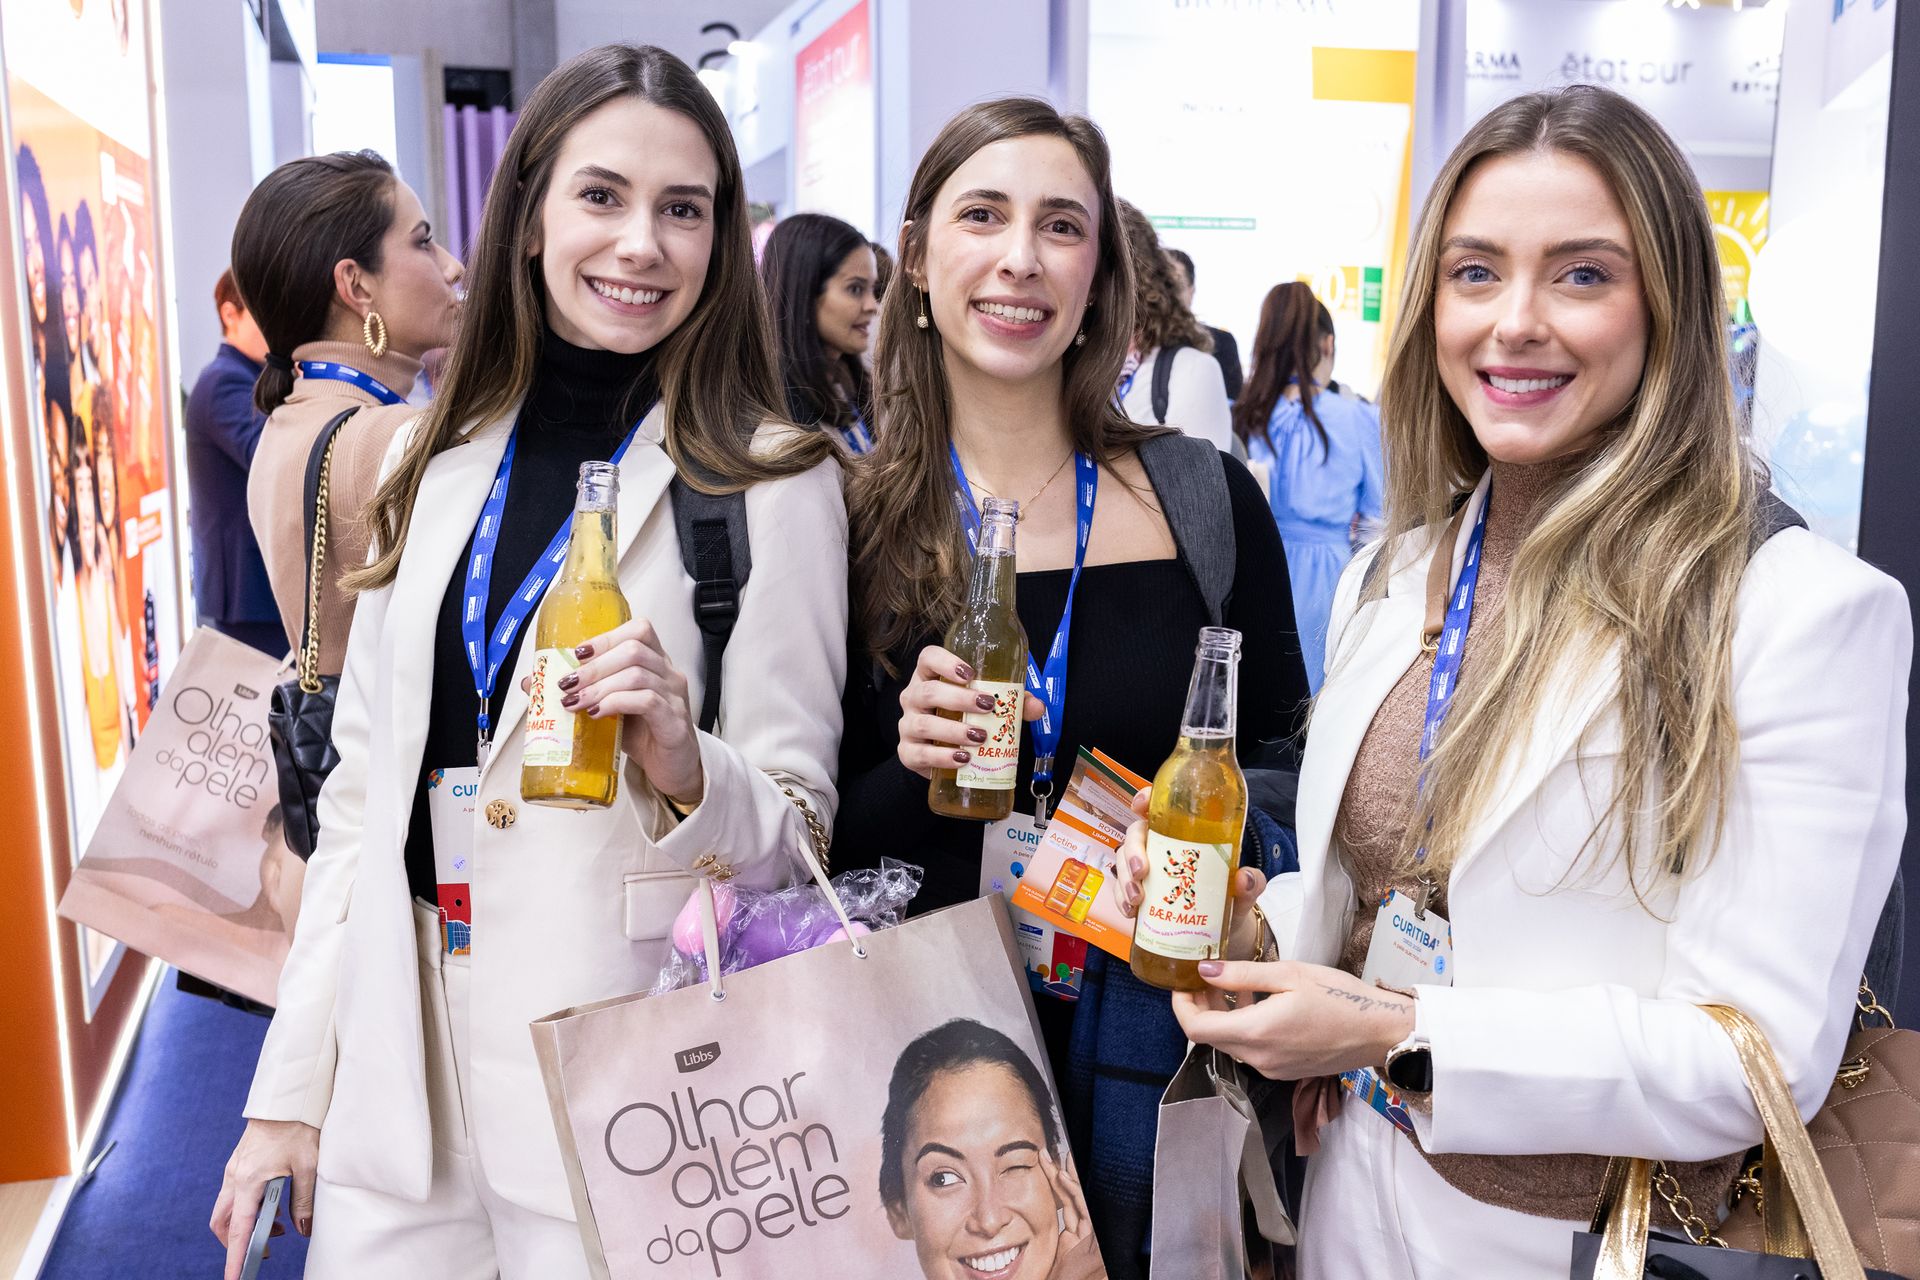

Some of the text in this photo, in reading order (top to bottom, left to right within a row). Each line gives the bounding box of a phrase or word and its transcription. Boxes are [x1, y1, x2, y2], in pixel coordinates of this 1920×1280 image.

[1050, 832, 1078, 851] Actine
[1098, 822, 1125, 841] ROTIN
[1148, 905, 1209, 926] BÆR-MATE
[683, 1050, 714, 1067] Libbs
[604, 1071, 806, 1177] Olhar
[671, 1123, 839, 1209] além
[647, 1167, 851, 1278] da pele
